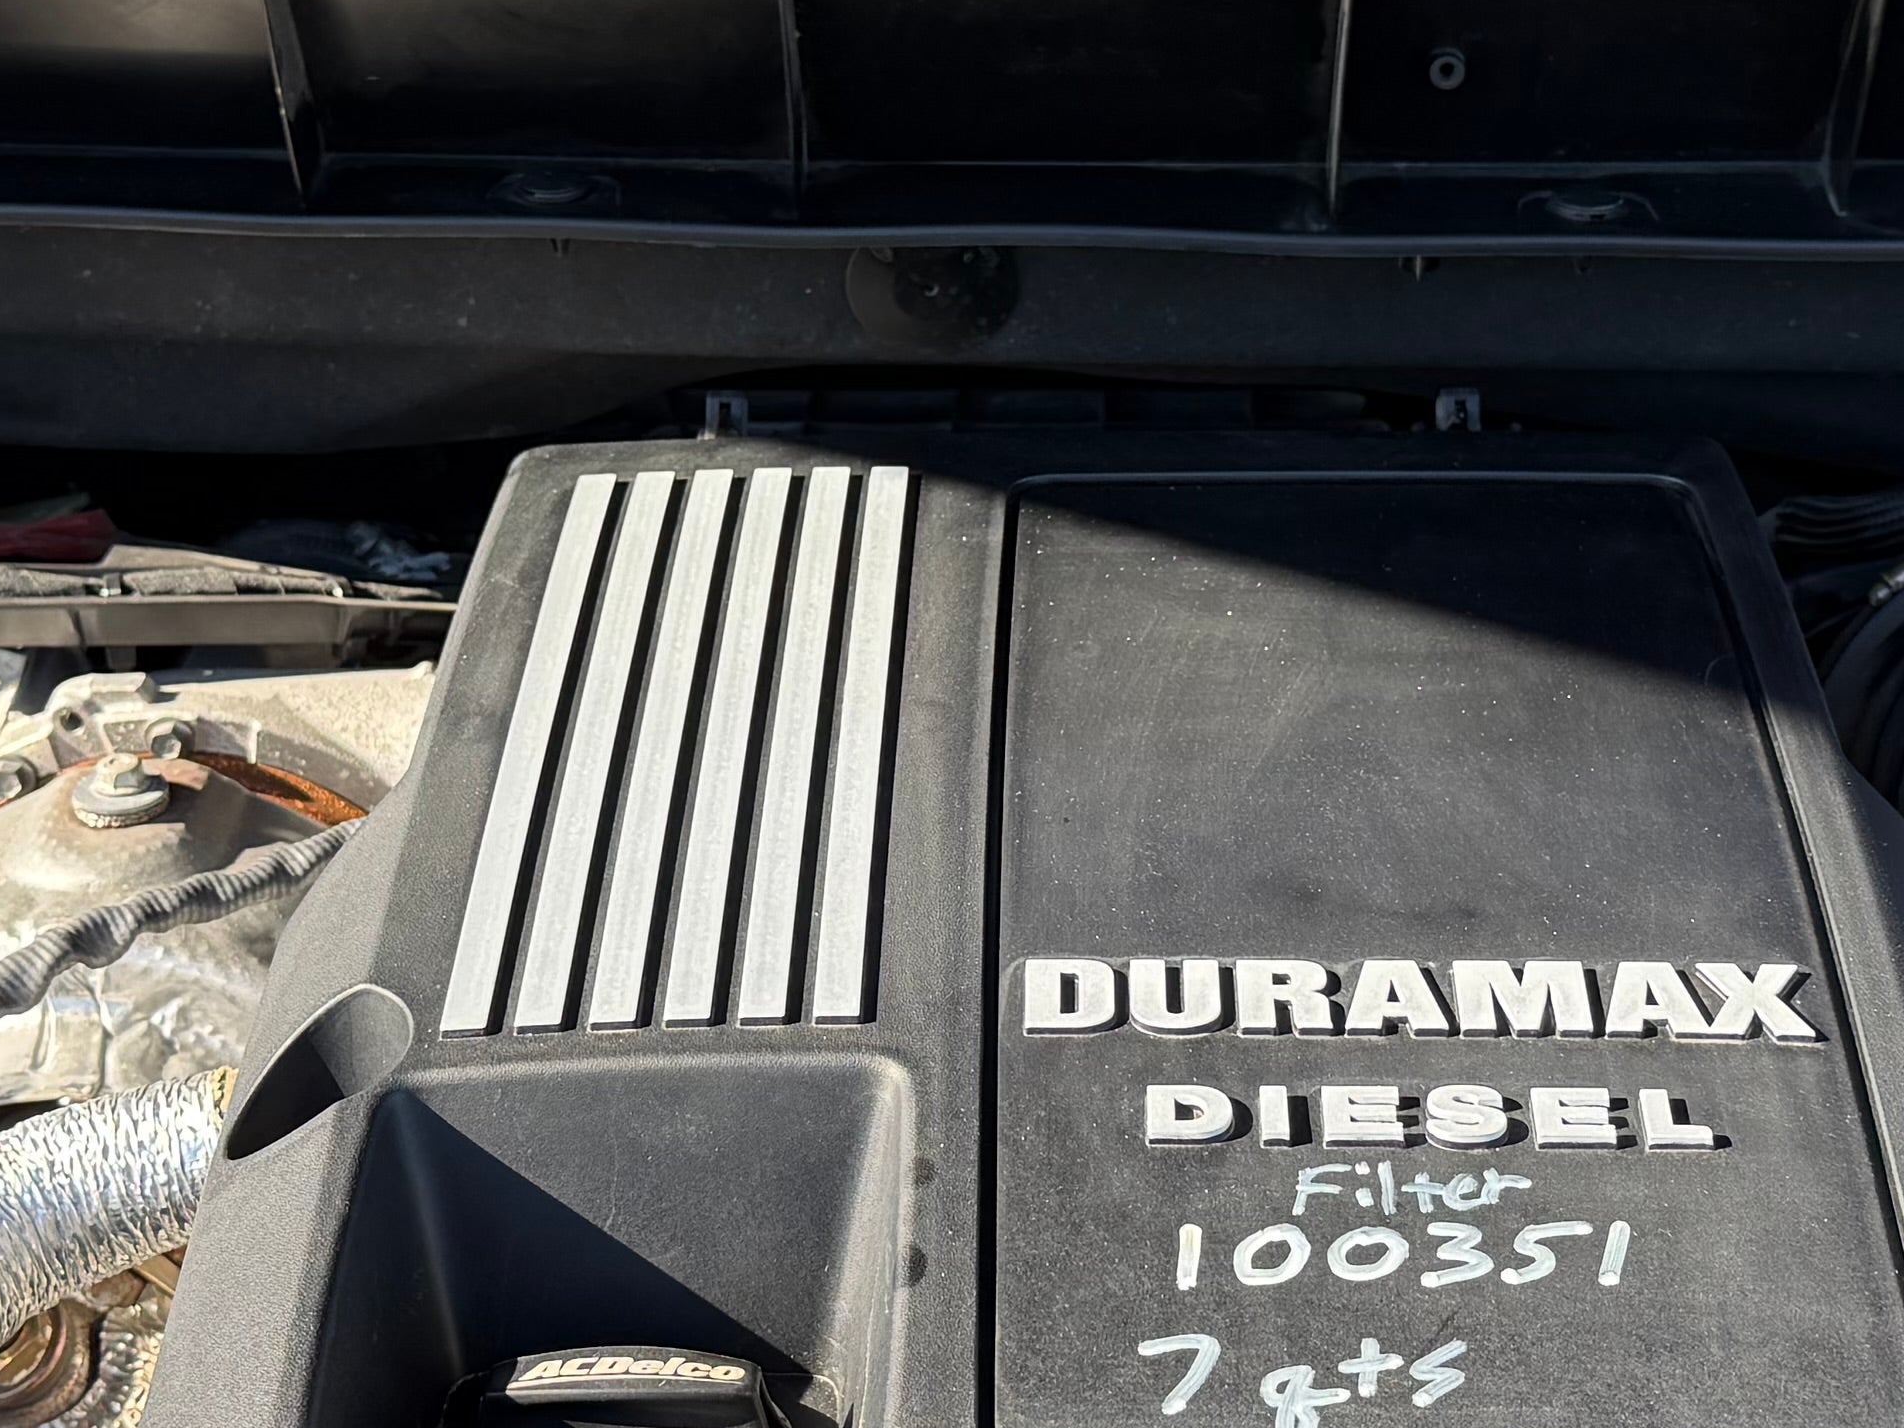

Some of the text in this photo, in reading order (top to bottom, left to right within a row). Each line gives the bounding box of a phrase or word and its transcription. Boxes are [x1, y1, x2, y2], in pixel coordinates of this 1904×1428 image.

[1022, 957, 1824, 1041] DURAMAX
[1144, 1083, 1726, 1152] DIESEL
[1290, 1160, 1533, 1217] Filter
[1175, 1218, 1633, 1292] 100351
[533, 1355, 747, 1382] ACDelco
[1136, 1332, 1222, 1416] 7
